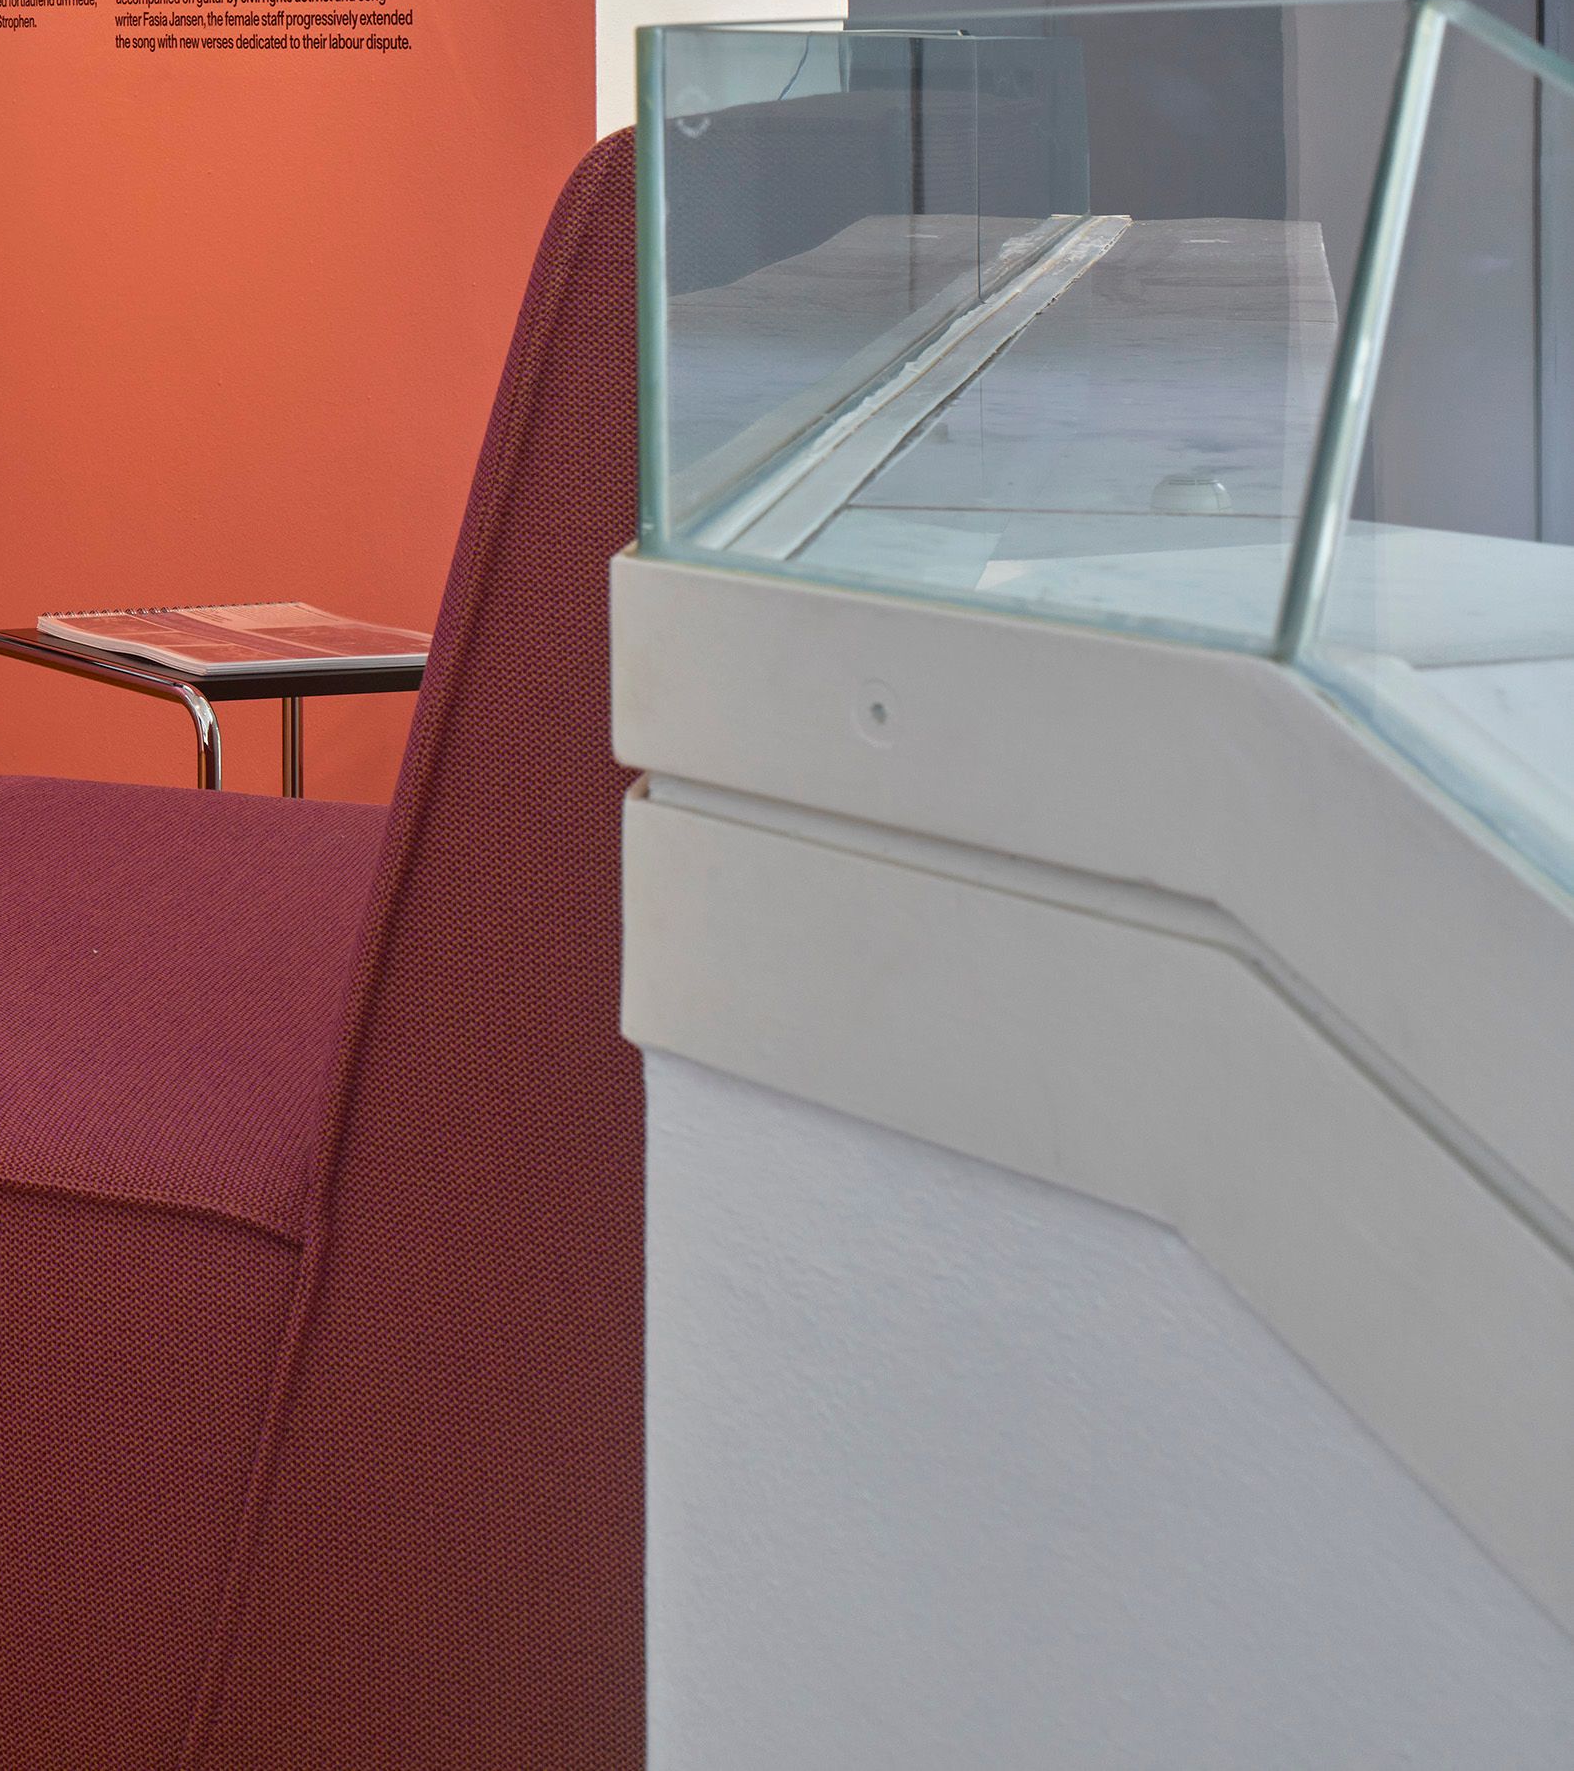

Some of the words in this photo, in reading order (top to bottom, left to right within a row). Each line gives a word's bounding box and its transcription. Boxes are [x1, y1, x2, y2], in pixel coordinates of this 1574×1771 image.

[114, 32, 131, 49] the
[131, 36, 156, 53] song
[155, 32, 178, 49] with
[178, 36, 200, 49] new
[199, 36, 235, 50] verses
[234, 32, 288, 50] dedicated
[288, 33, 301, 50] to
[300, 32, 328, 50] their
[327, 32, 365, 50] labour
[364, 32, 412, 54] dispute.
